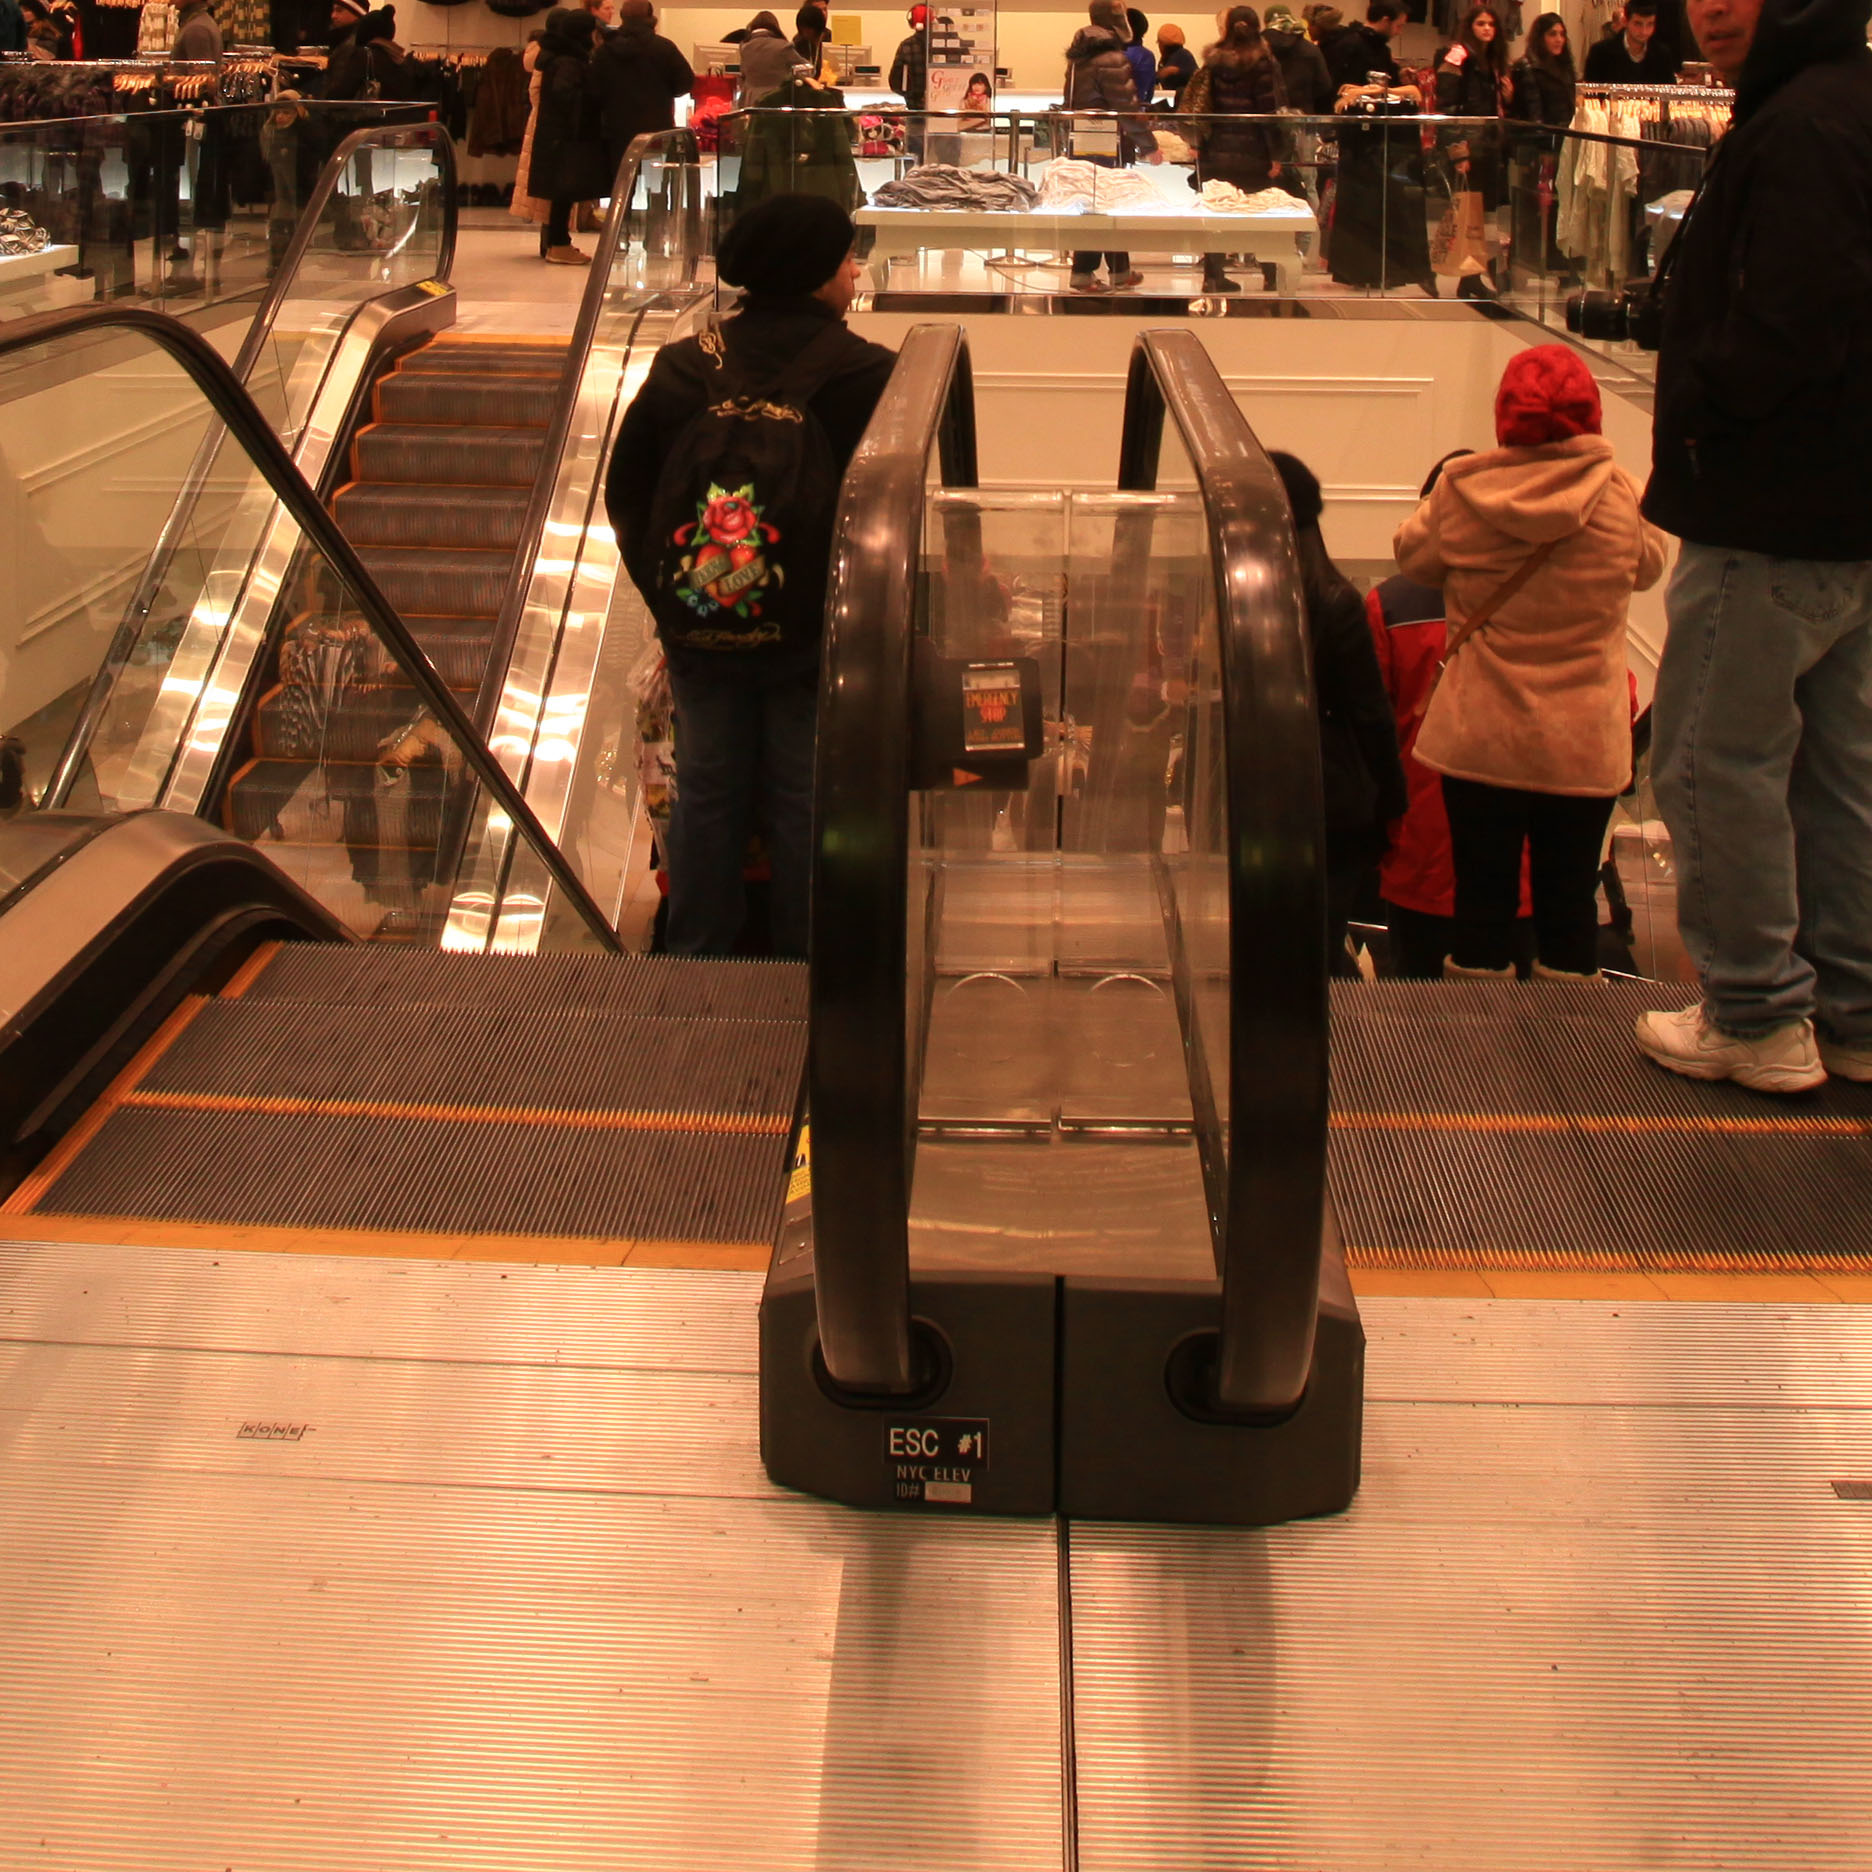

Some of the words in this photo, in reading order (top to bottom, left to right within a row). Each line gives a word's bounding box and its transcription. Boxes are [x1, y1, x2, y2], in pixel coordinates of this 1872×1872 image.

[243, 1424, 301, 1435] KONE
[889, 1427, 940, 1458] ESC
[957, 1431, 983, 1460] #1
[896, 1464, 927, 1481] NYC
[933, 1466, 972, 1483] ELEV
[895, 1481, 921, 1498] ID#
